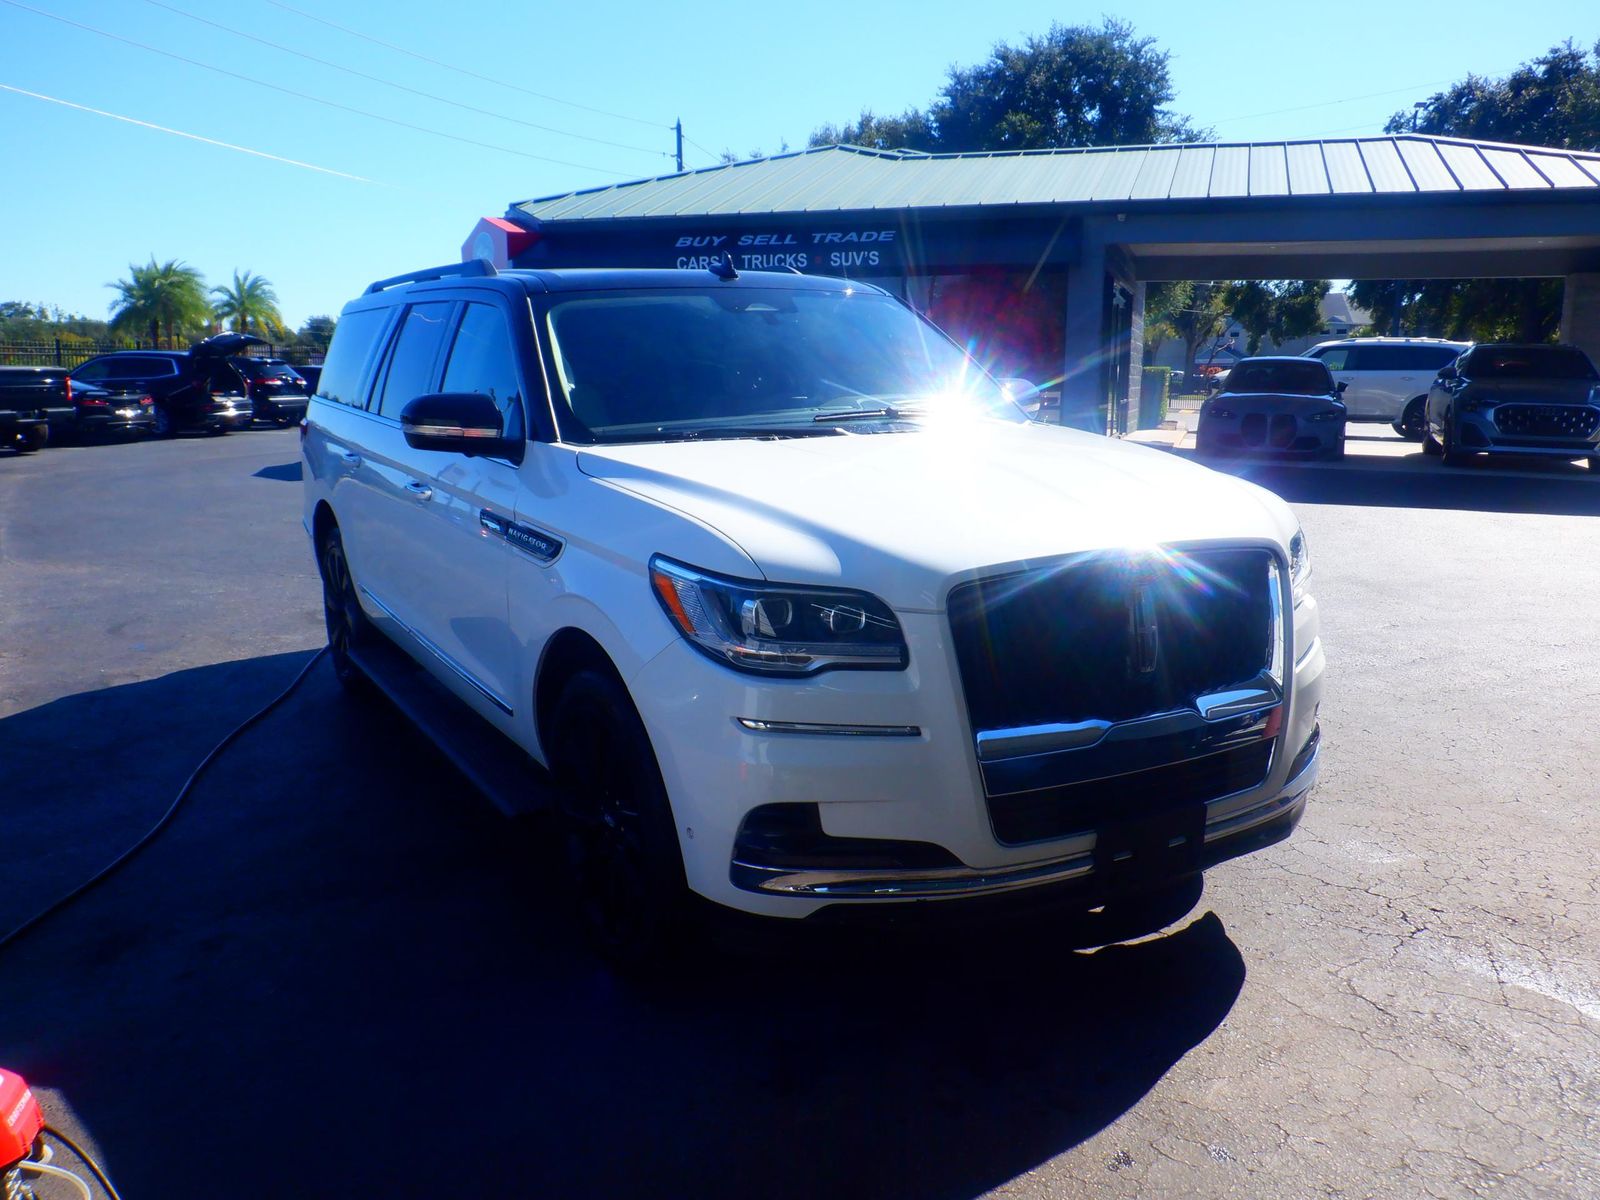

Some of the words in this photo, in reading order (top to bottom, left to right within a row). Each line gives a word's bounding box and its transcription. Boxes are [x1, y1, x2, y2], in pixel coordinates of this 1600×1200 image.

[675, 236, 727, 247] BUY
[738, 235, 797, 245] SELL
[812, 231, 896, 243] TRADE
[676, 256, 719, 270] CARS
[741, 253, 807, 268] TRUCKS
[830, 251, 879, 266] SUV'S
[508, 527, 547, 550] NAVIGATOR
